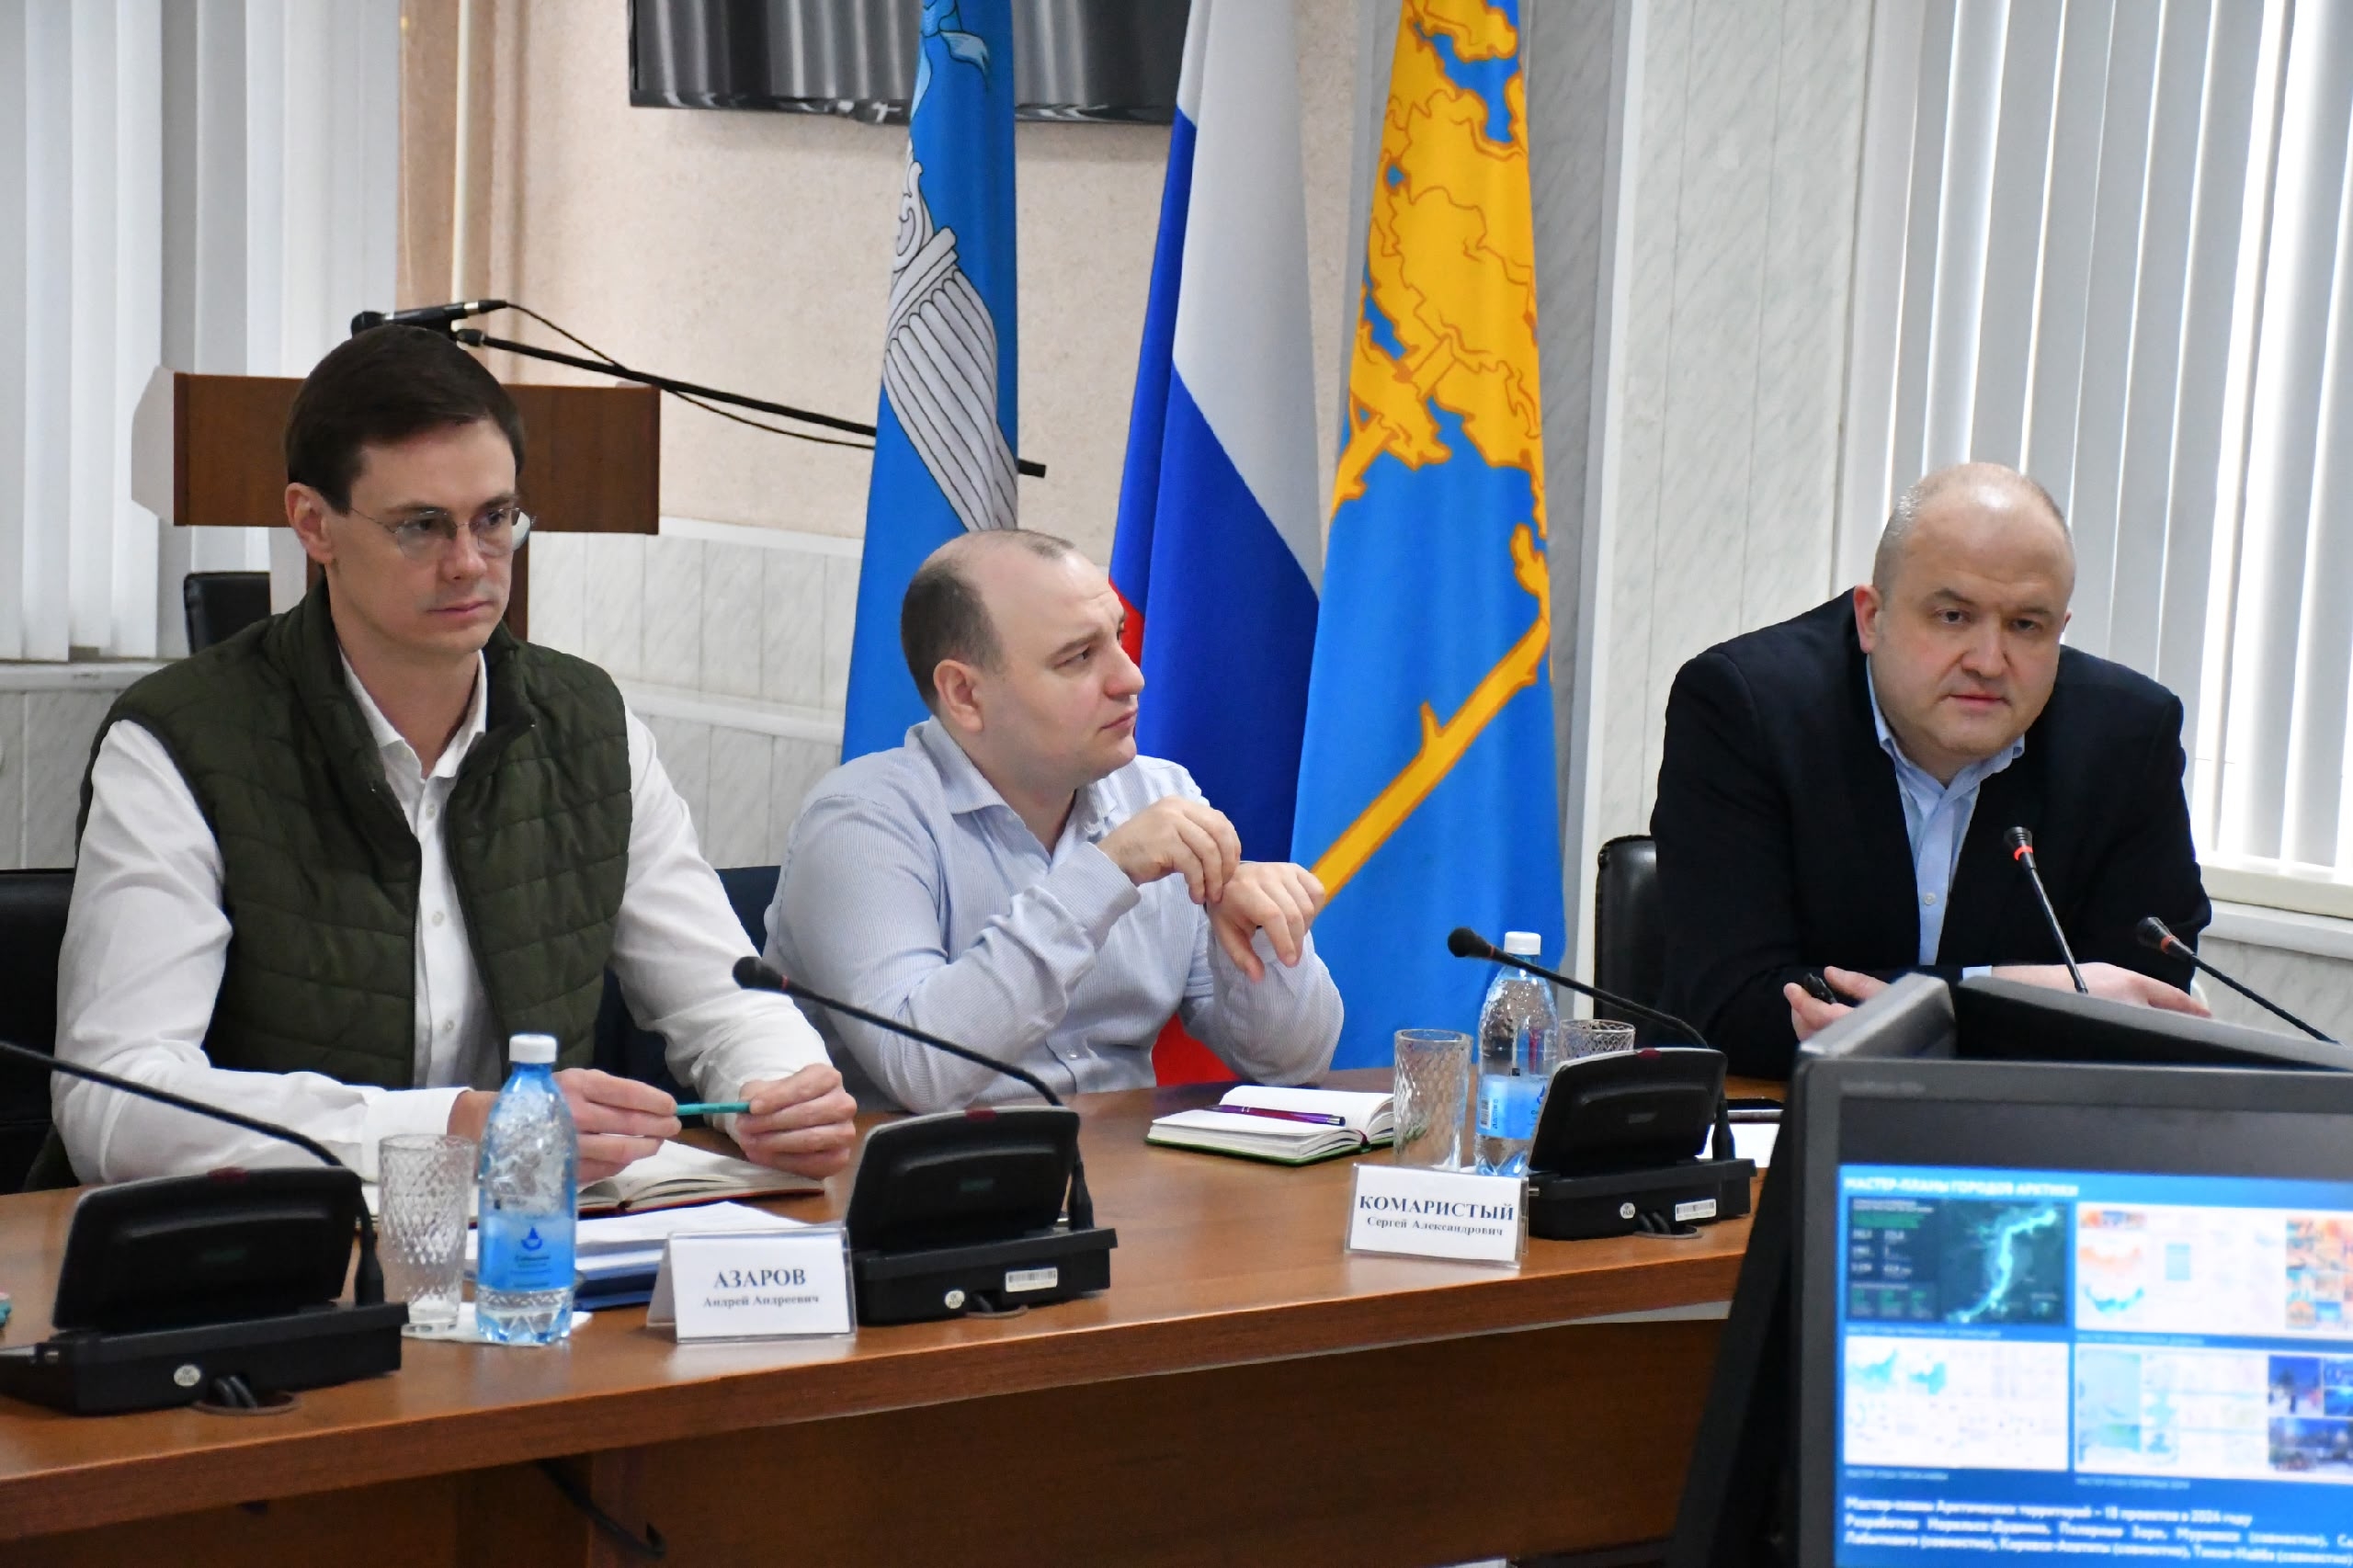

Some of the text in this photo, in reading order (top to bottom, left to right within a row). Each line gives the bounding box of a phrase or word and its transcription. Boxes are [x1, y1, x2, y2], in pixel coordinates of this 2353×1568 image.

[1358, 1195, 1515, 1221] КОМАРИСТЫЙ
[1367, 1216, 1504, 1237] Сергей Александрович
[713, 1268, 807, 1289] АЗАРОВ
[702, 1295, 820, 1309] Андрей Андреевич
[2190, 1508, 2221, 1522] 2024
